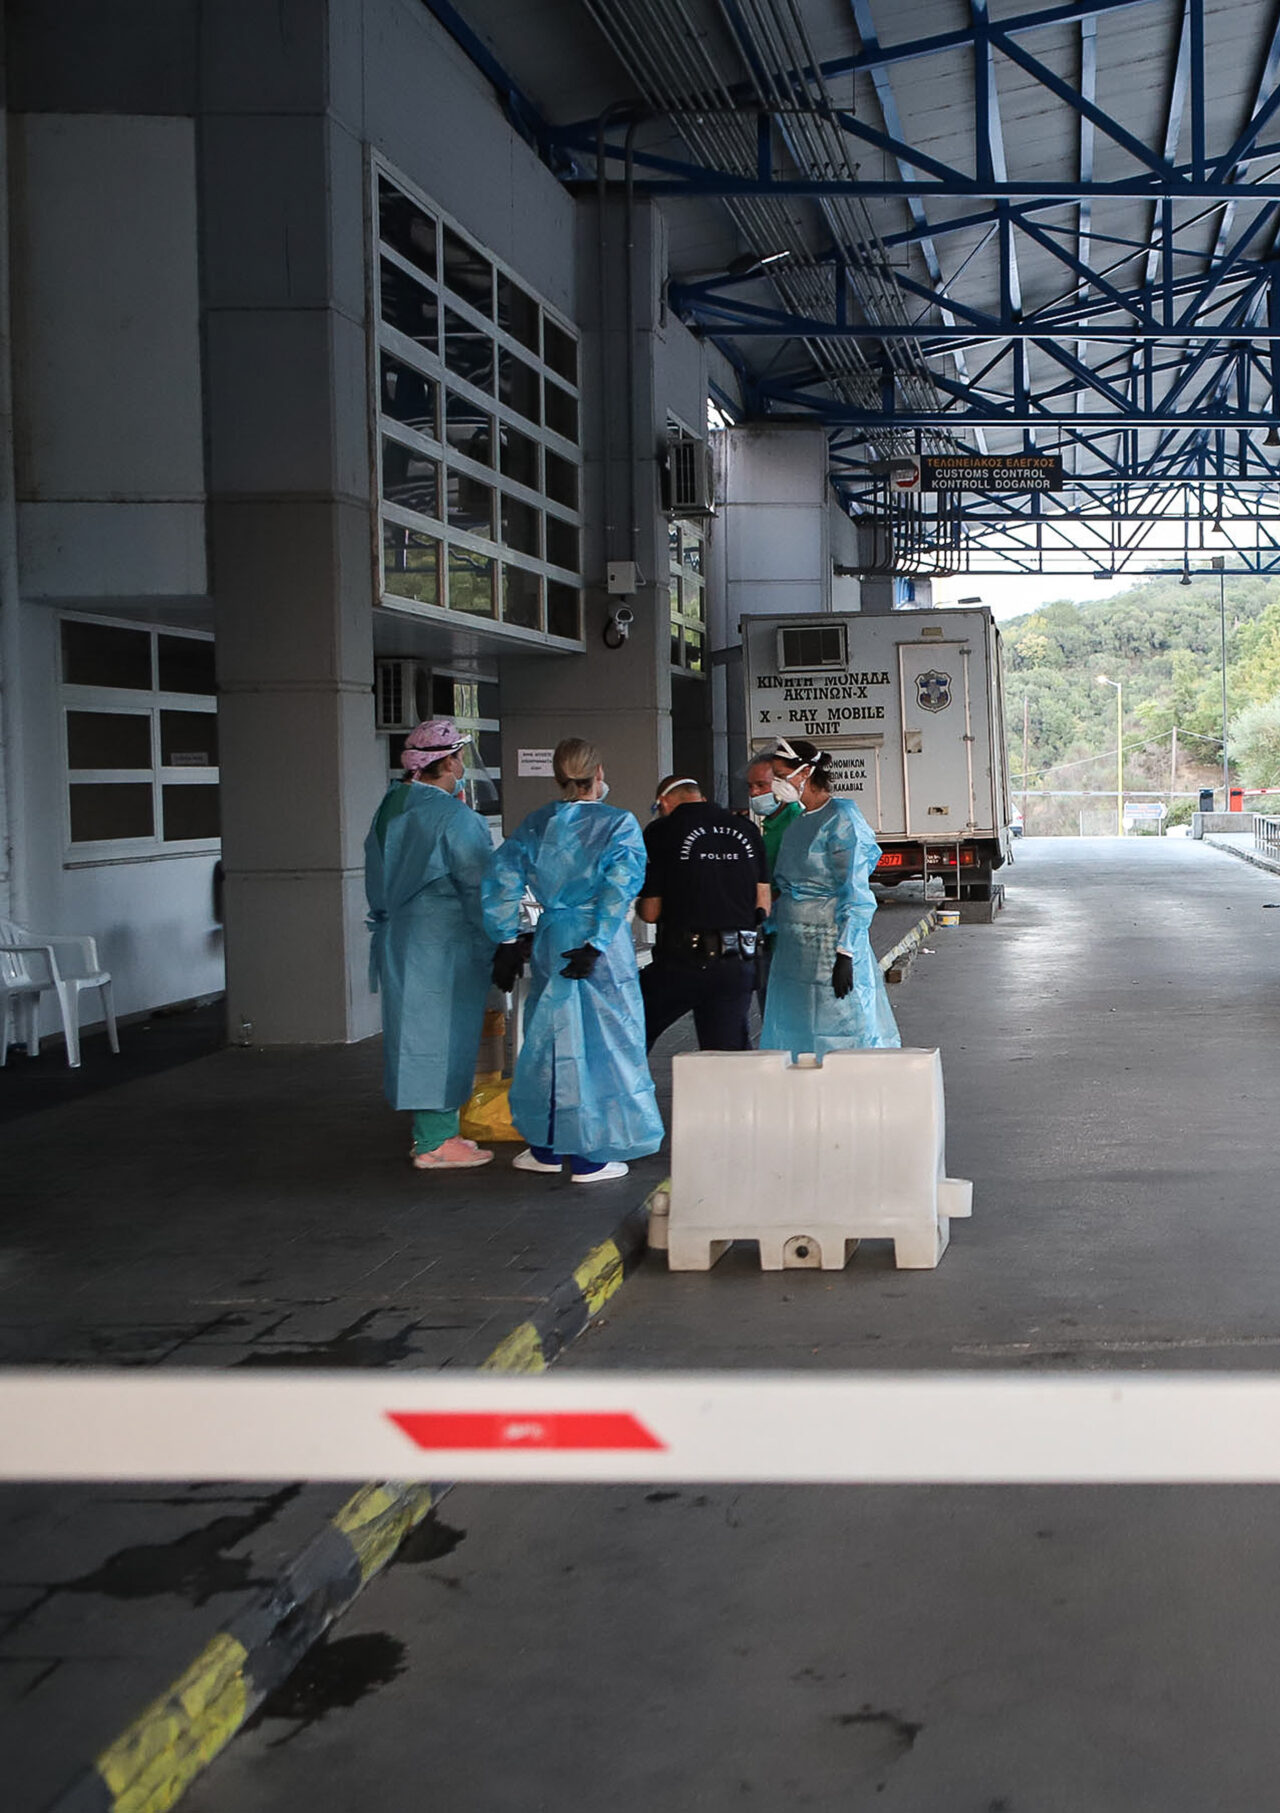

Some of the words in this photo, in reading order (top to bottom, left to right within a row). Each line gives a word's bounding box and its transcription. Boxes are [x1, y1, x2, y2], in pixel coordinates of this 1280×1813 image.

[927, 458, 1004, 468] ΤΕΛΩΝΕΙΑΚΟΣ
[1006, 458, 1055, 468] ΕΛΕΓΧΟΣ
[935, 468, 989, 478] CUSTOMS
[993, 468, 1046, 478] CONTROL
[931, 479, 991, 489] KONTROLL
[995, 479, 1051, 489] DOGANOR
[824, 672, 890, 687] ΜΟΝΑΔΑ
[783, 686, 868, 701] ΑΚΤΙΝΩΝ-Χ
[789, 709, 818, 722] RAY
[828, 706, 885, 721] MOBILE
[805, 721, 840, 735] UNIT
